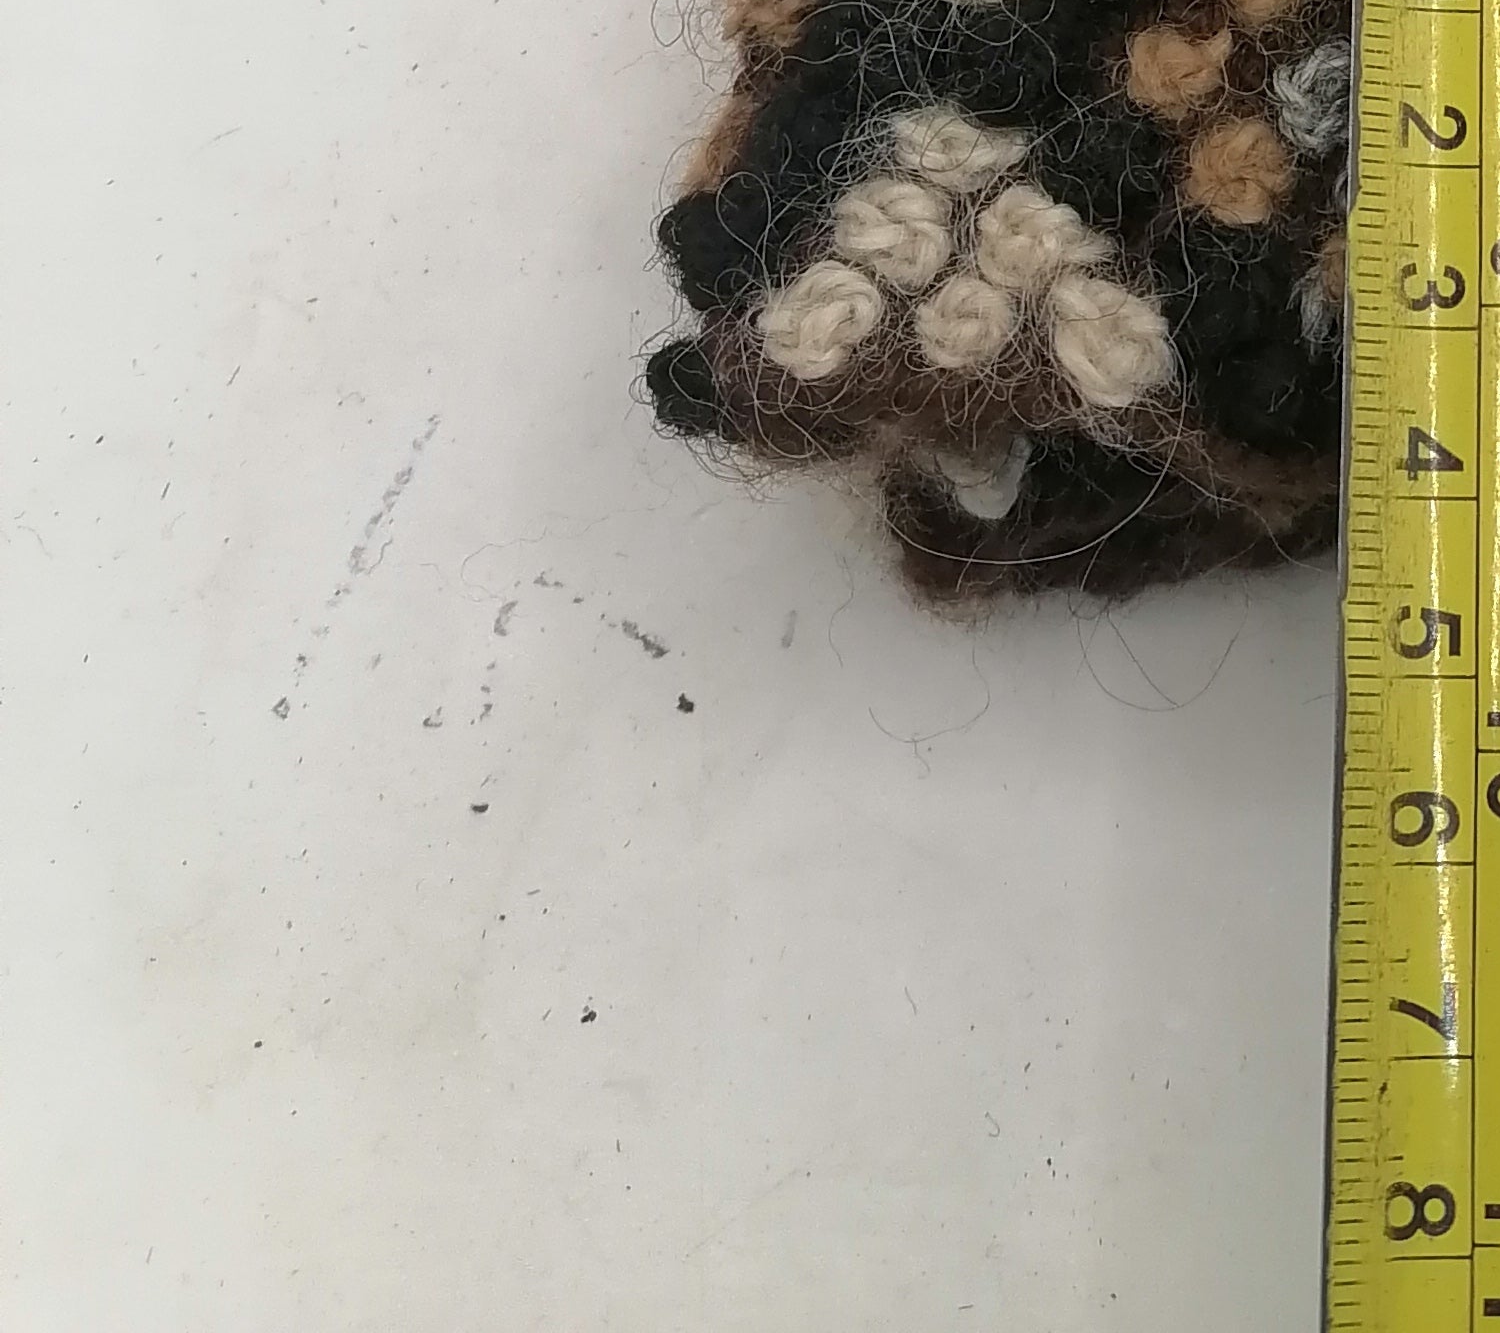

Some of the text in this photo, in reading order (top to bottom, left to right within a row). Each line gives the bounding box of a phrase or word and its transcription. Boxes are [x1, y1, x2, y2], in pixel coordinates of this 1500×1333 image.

[1400, 101, 1467, 152] 2
[1401, 262, 1466, 312] 3
[1396, 426, 1464, 481] 4
[1391, 604, 1462, 659] 5
[1390, 790, 1460, 847] 6
[1388, 981, 1458, 1040] 7
[1385, 1181, 1456, 1241] 8
